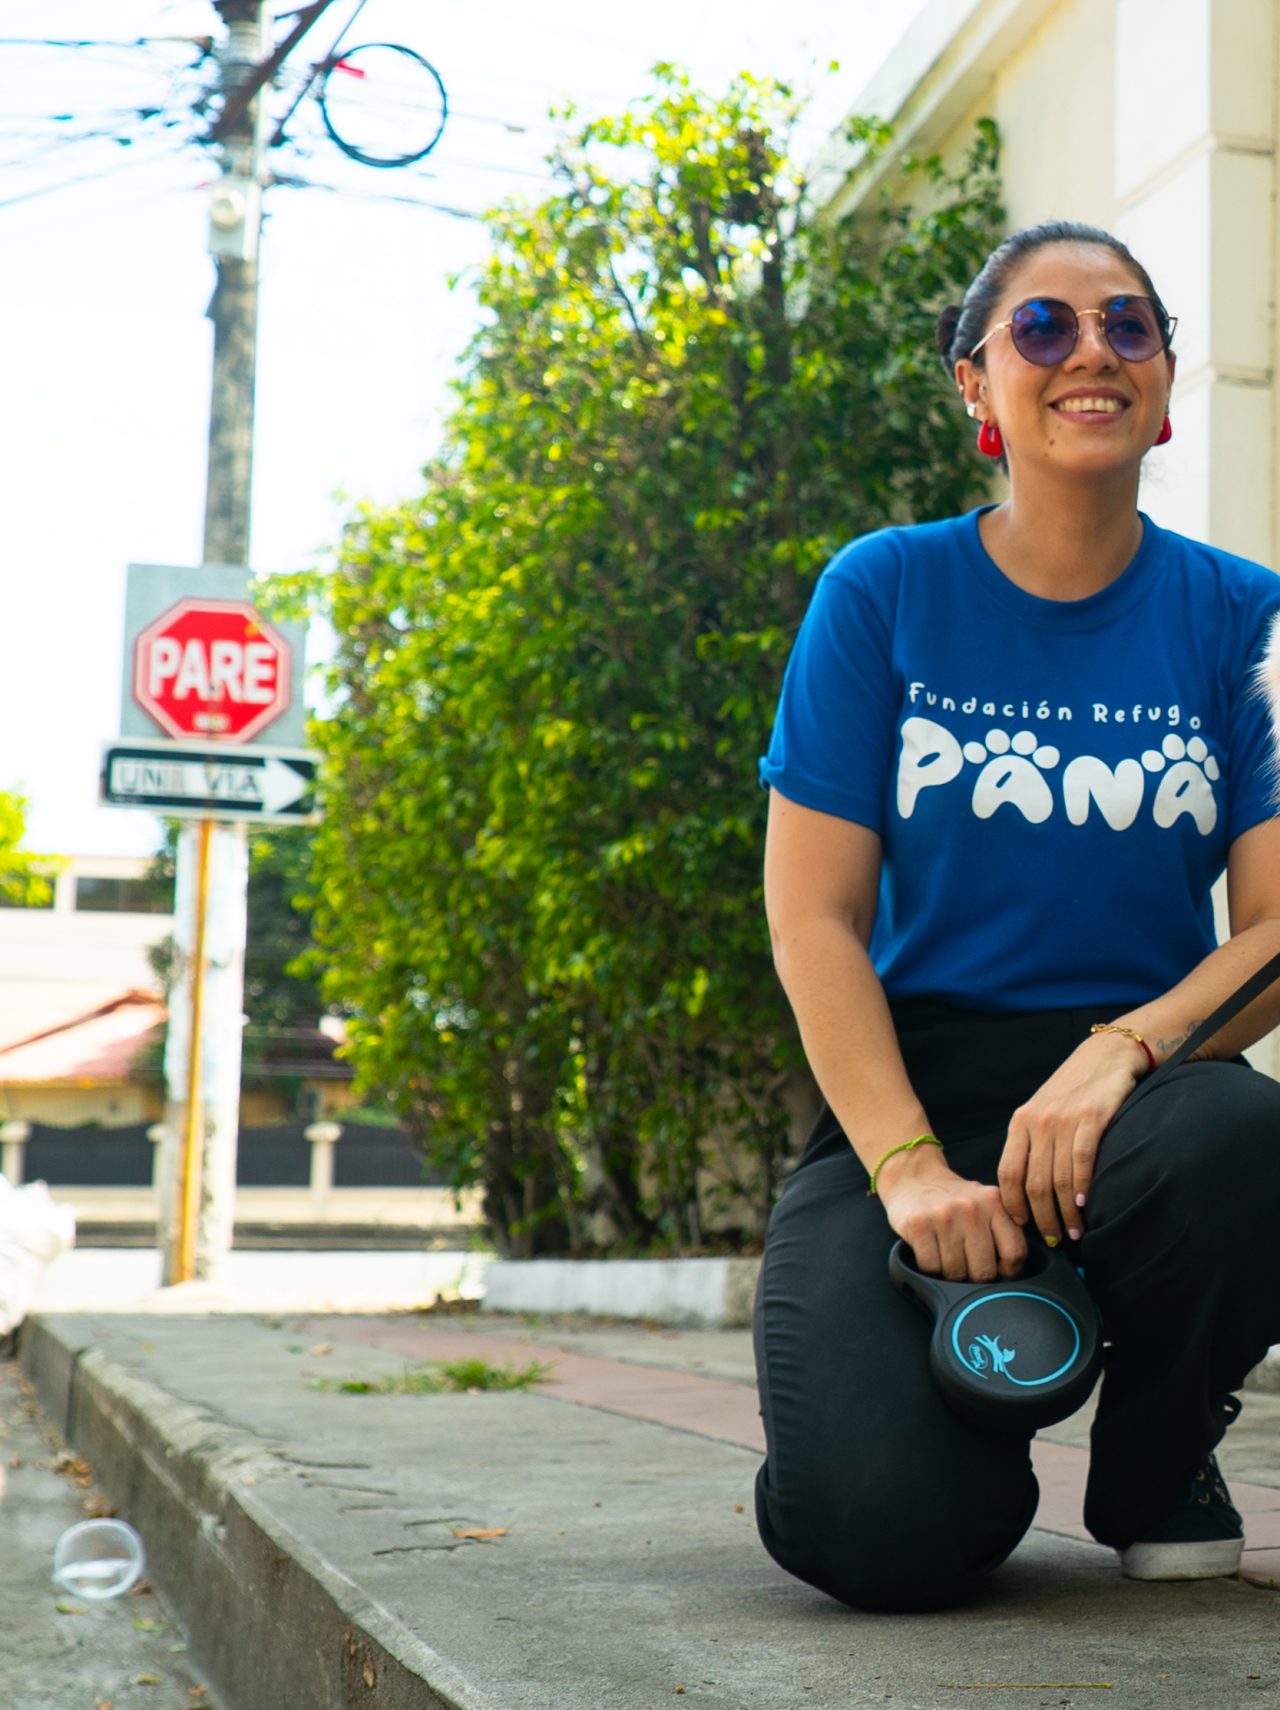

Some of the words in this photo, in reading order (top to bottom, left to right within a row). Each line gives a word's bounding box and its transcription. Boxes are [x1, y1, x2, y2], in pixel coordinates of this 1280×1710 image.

[150, 636, 275, 704] PARE
[909, 682, 1073, 721] Fundación
[203, 765, 260, 801] VIA
